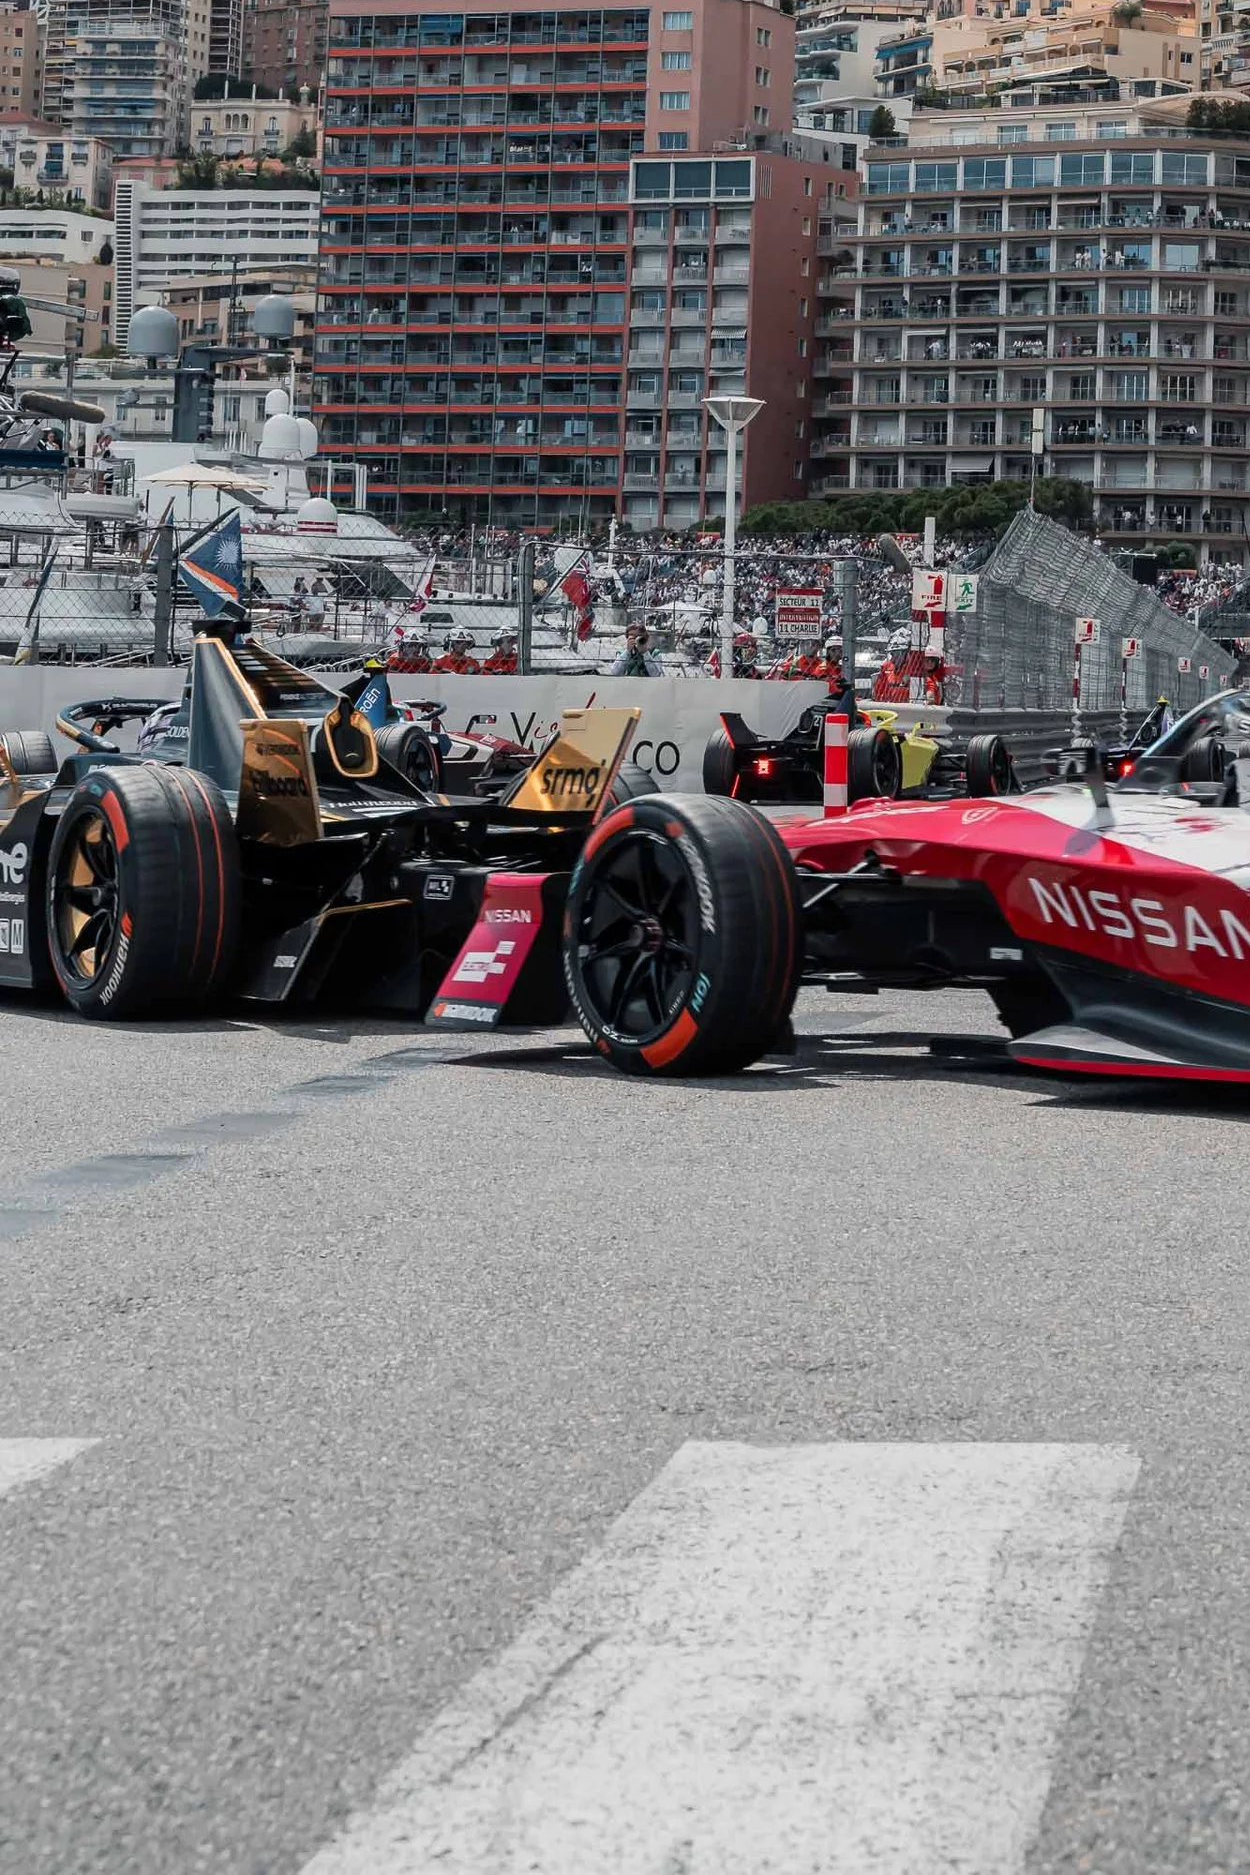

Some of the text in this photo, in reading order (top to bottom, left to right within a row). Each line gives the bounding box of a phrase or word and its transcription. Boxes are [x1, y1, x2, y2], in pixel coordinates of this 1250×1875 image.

[779, 597, 807, 607] SECTEUR
[779, 624, 818, 633] 11 CHARLIE
[484, 909, 532, 924] NISSAN
